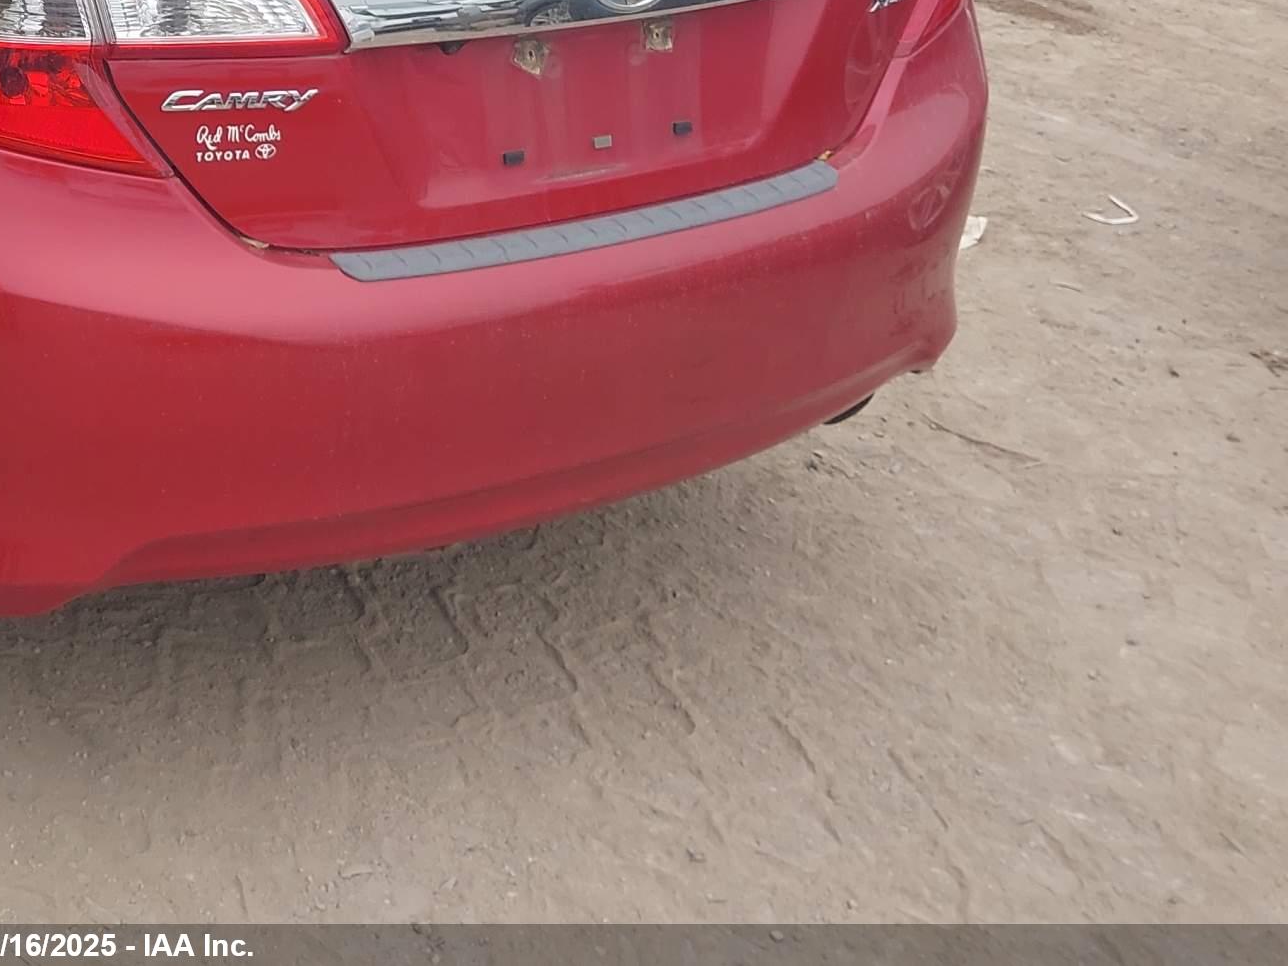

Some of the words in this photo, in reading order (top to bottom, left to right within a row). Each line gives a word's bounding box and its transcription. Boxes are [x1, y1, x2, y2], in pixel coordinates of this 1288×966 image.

[161, 89, 318, 112] CAMRY
[196, 125, 223, 151] Red
[196, 150, 250, 162] TOYOTA
